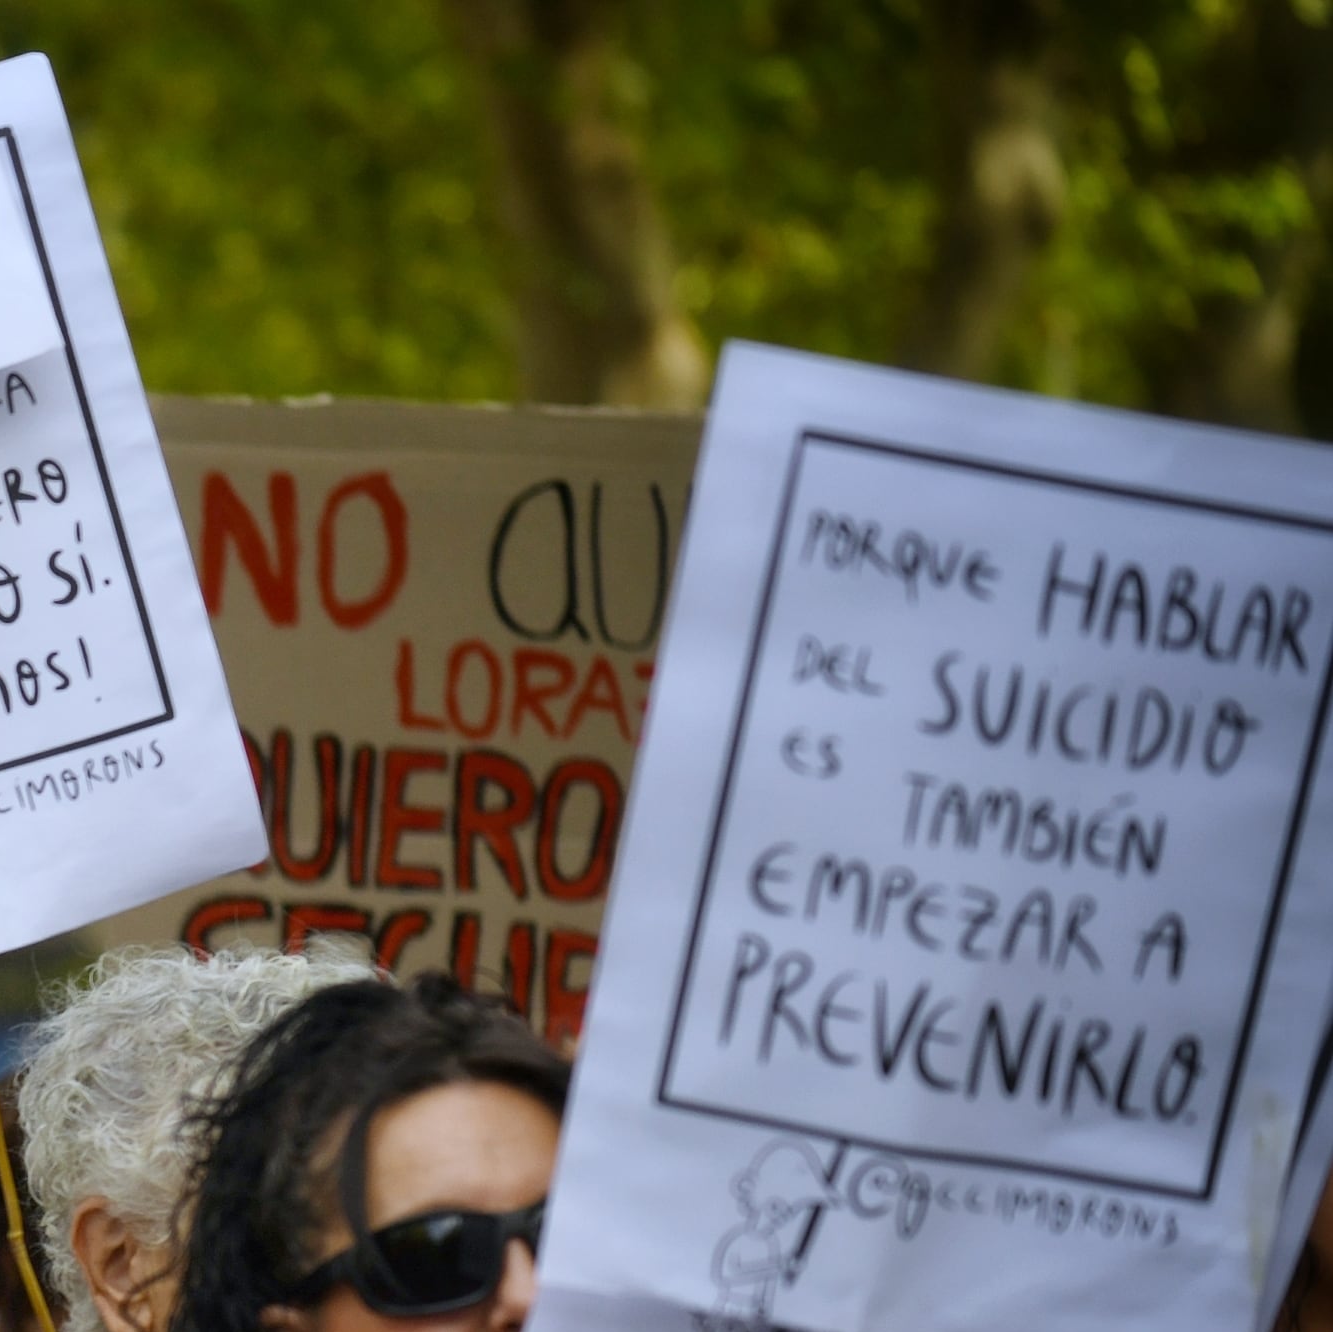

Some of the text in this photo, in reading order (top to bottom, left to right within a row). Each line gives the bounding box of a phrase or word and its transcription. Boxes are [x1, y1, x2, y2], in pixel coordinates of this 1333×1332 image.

[48, 520, 111, 605] SÍ.
[199, 468, 692, 652] NO QU
[799, 508, 1314, 674] PORQUE HABLAR
[790, 632, 1262, 779] DEL SUICIDIO
[241, 725, 625, 903] UIERO
[780, 727, 1167, 877] ES TAMBIÉN
[748, 840, 1188, 985] EMPEZAR A
[717, 931, 1204, 1126] PREVENIRLO.
